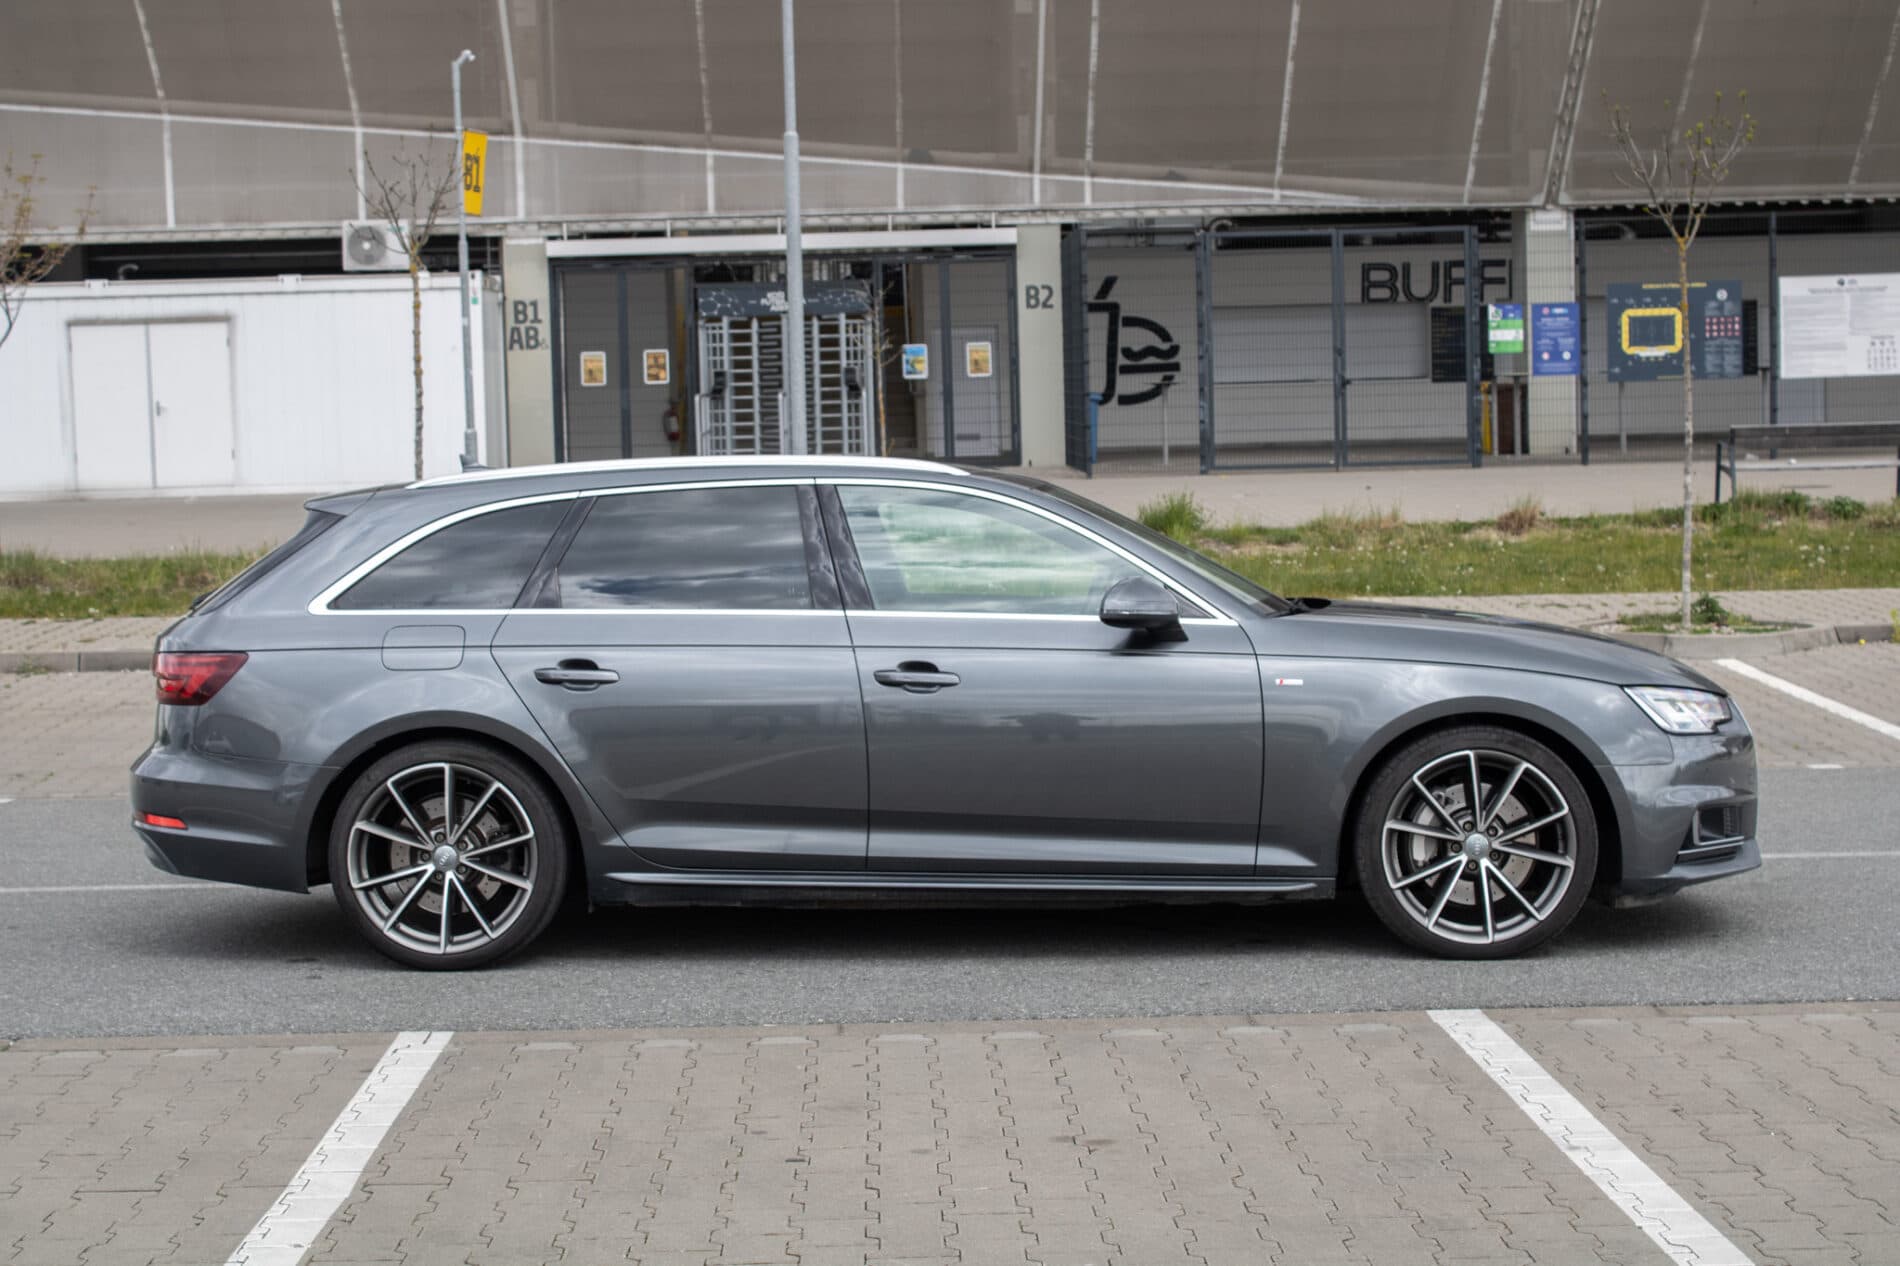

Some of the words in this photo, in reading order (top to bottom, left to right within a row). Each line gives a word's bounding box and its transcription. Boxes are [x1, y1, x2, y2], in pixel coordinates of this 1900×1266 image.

[464, 152, 481, 192] B1
[1025, 284, 1055, 310] B2
[513, 299, 543, 324] B1
[509, 325, 540, 351] AB
